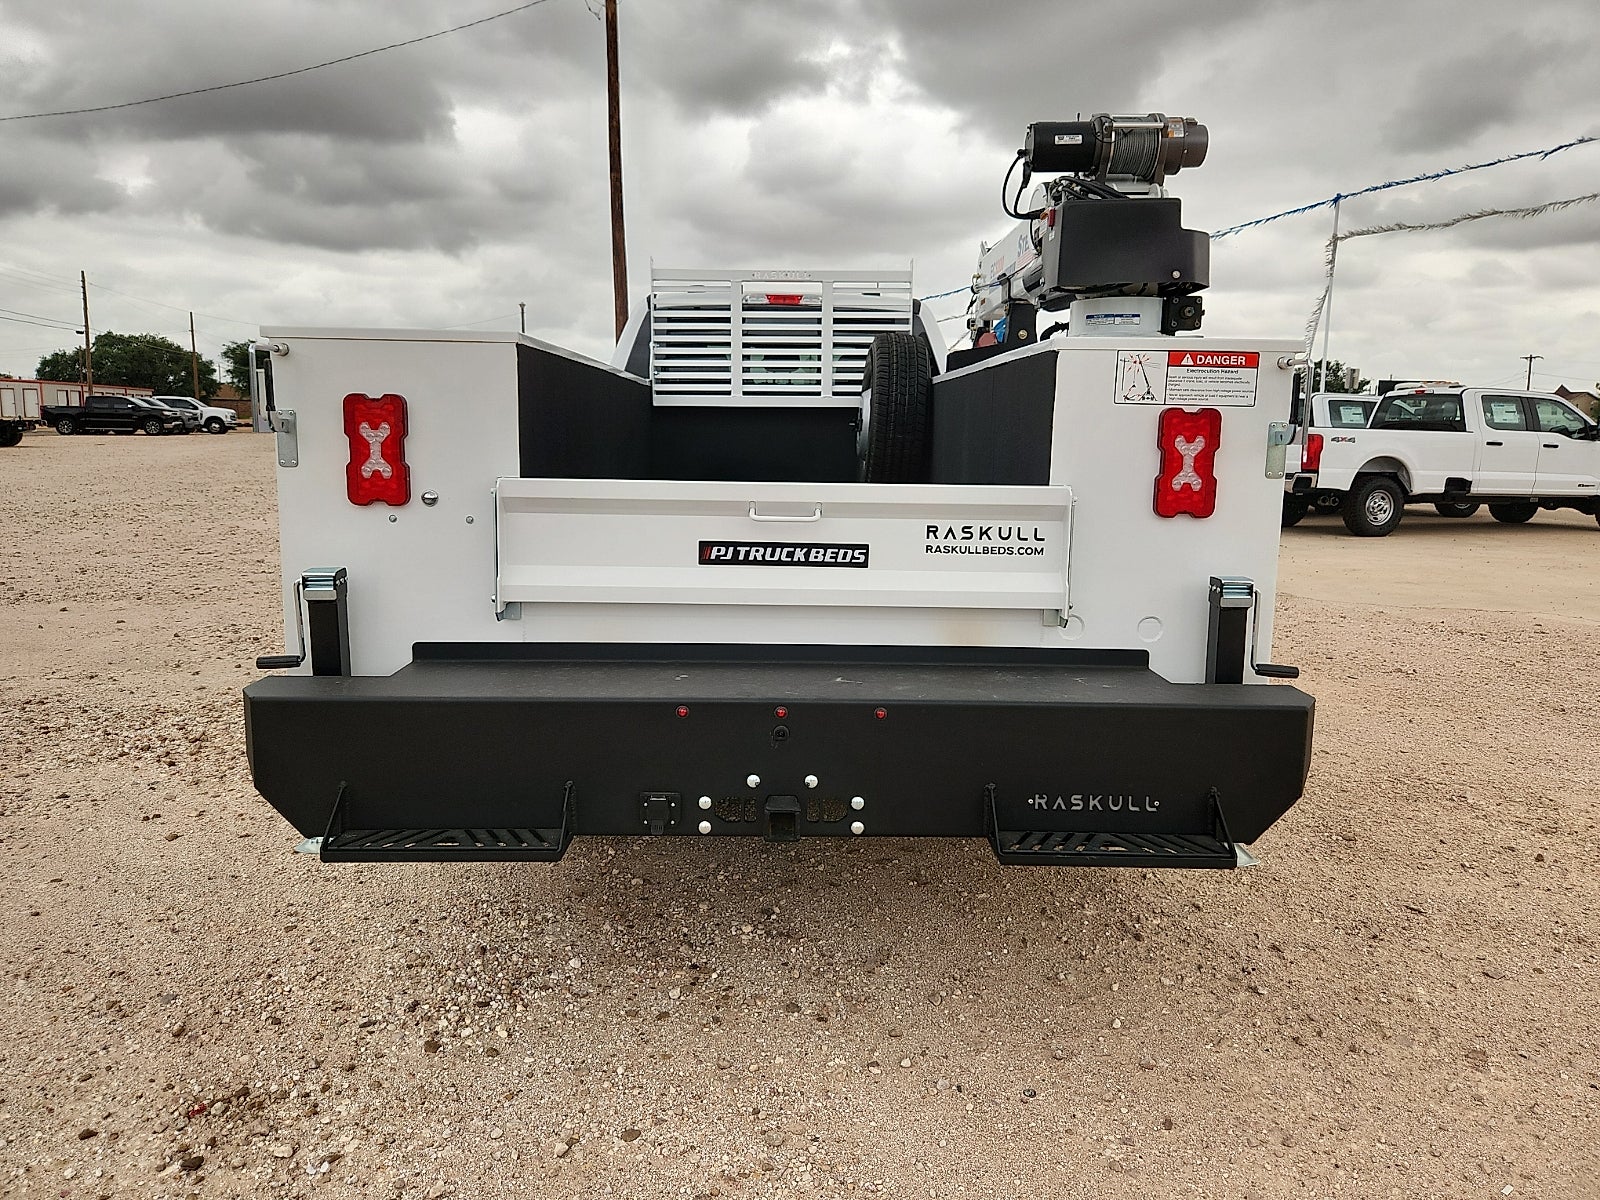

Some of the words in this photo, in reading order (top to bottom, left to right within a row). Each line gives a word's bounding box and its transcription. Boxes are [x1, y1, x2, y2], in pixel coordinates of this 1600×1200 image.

[1196, 354, 1246, 366] DANGER
[926, 525, 1046, 541] RASKULL
[710, 546, 734, 560] PJ
[736, 547, 808, 561] TRUCK
[808, 548, 867, 563] BEDS
[925, 544, 1044, 556] RASKULLBEDS.COM
[1034, 794, 1158, 812] RASKULL
